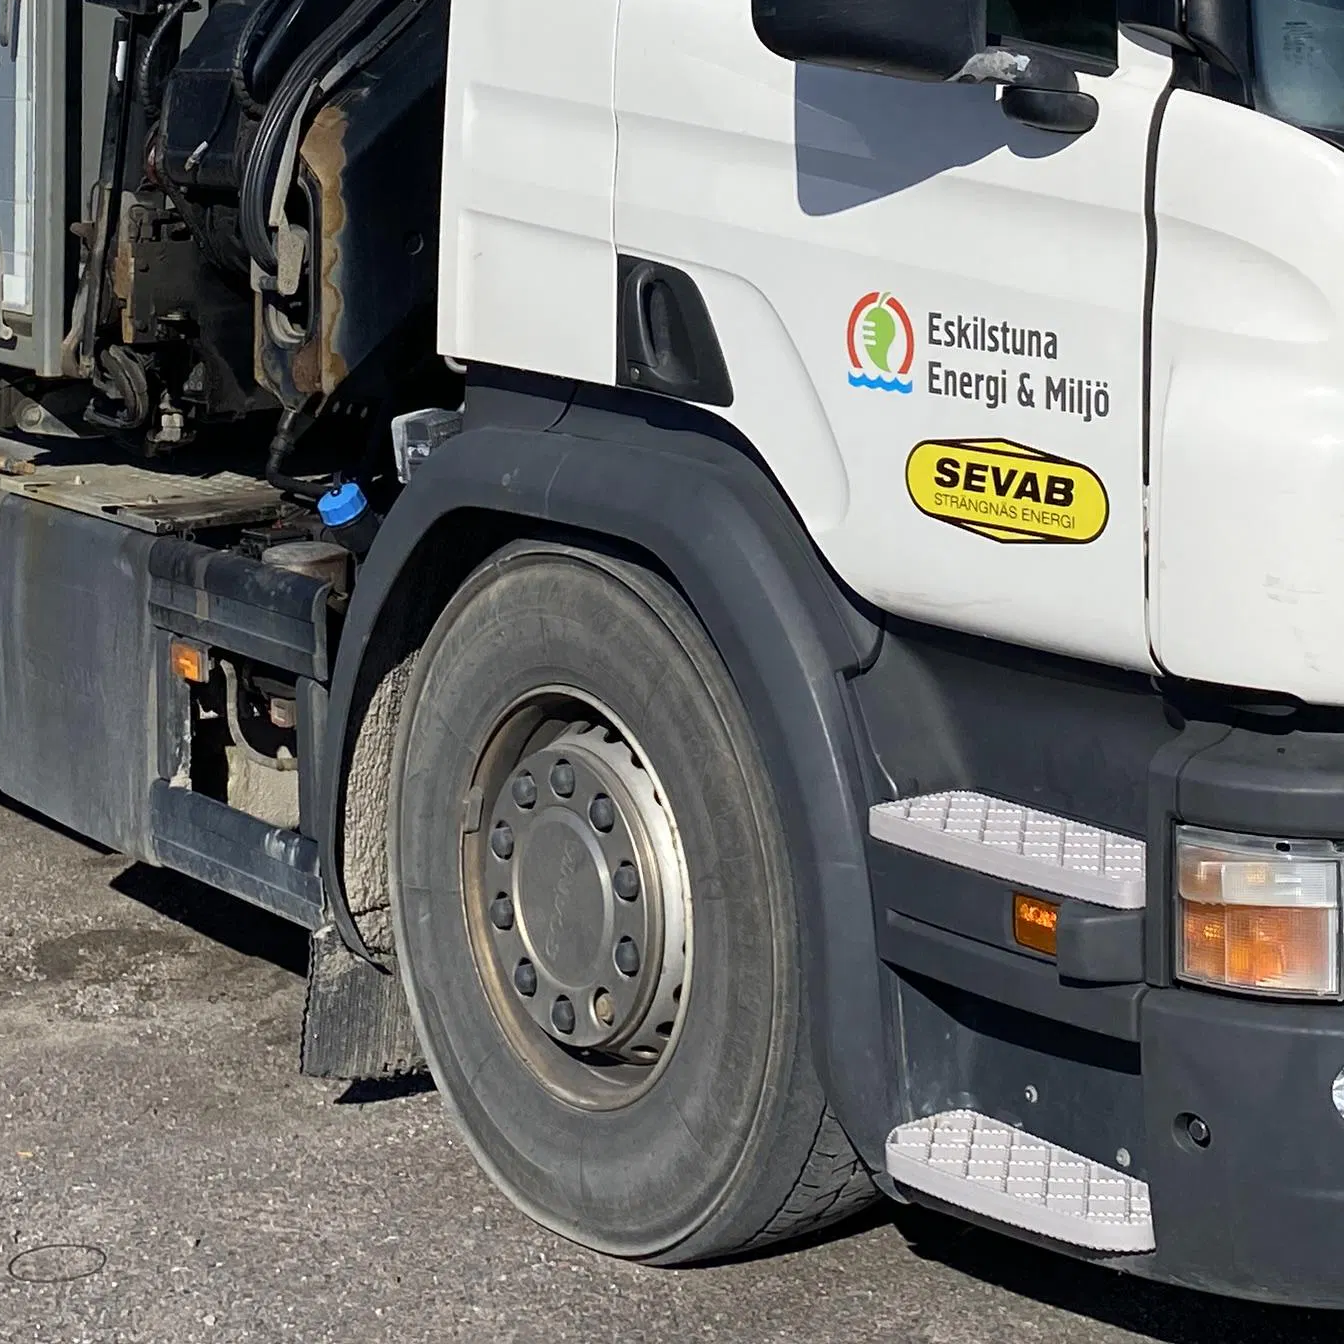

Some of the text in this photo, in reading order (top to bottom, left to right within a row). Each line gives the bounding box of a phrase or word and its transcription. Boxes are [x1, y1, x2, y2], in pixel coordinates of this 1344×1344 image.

[928, 311, 1058, 360] Eskilstuna
[928, 361, 1110, 422] Energi & Miljö
[934, 457, 1074, 507] SEVAB
[934, 492, 1076, 529] STRÄNGNÄS ENERGI
